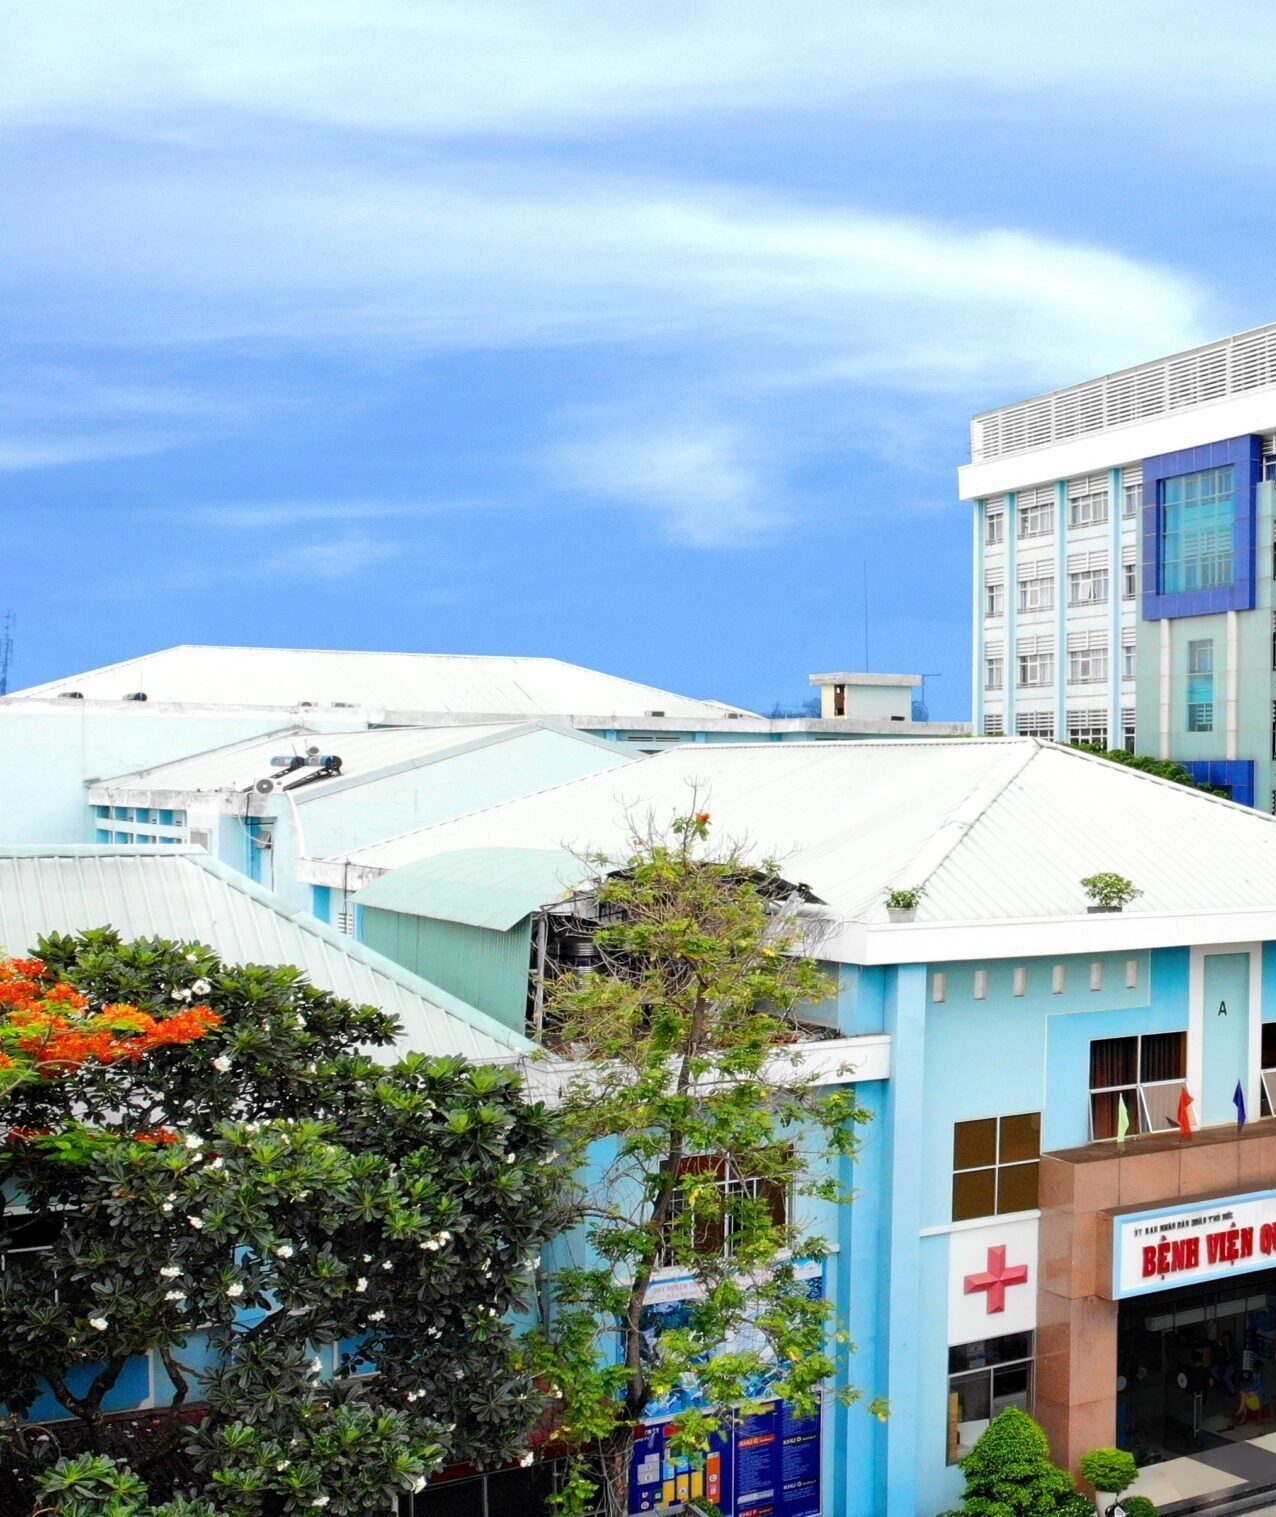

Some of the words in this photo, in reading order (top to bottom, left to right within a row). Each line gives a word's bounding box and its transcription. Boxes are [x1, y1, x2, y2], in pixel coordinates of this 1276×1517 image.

[1217, 1000, 1228, 1017] A
[1142, 1234, 1200, 1280] BỆNH
[1206, 1221, 1254, 1266] VIỆN
